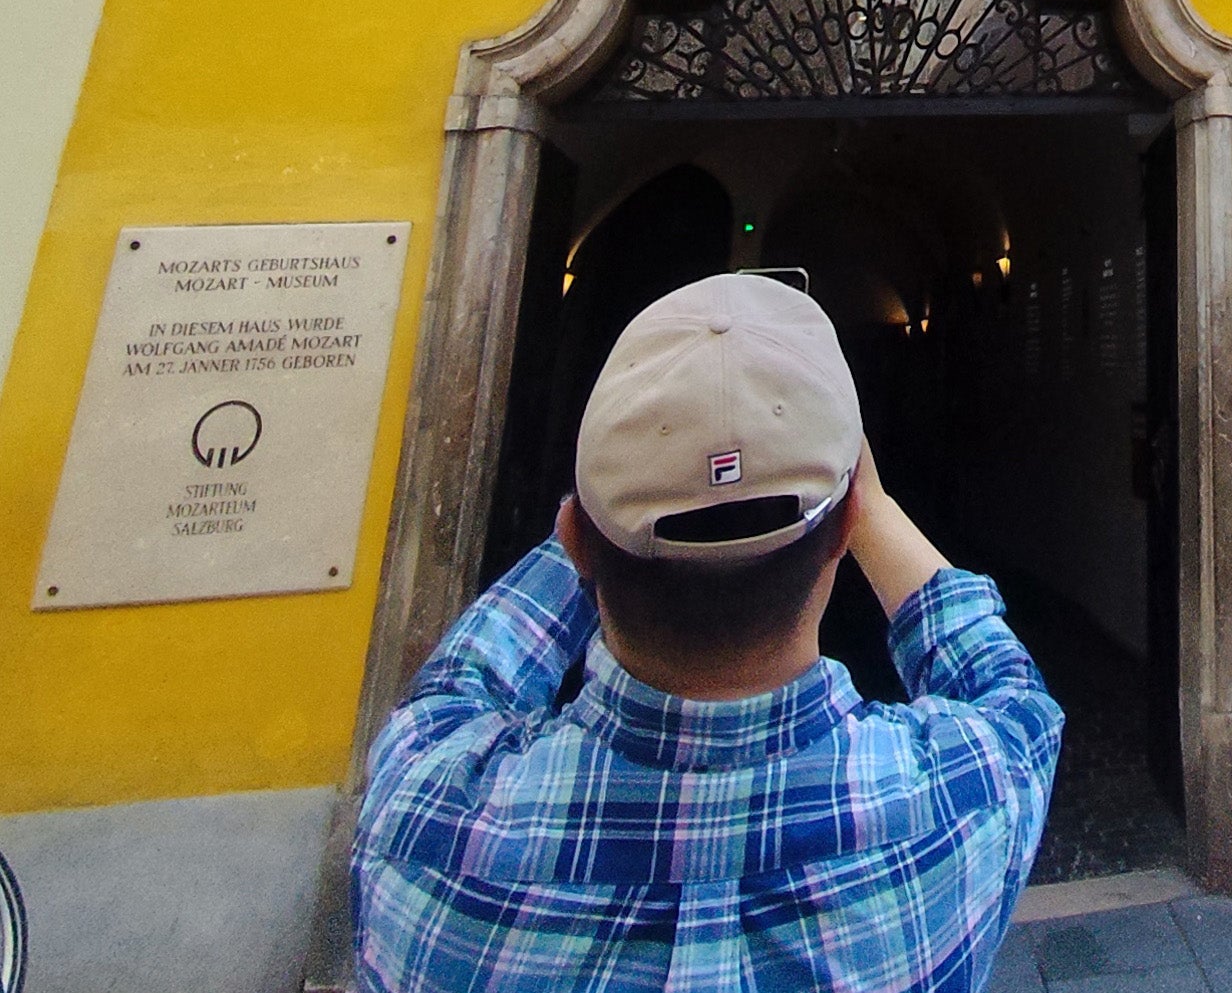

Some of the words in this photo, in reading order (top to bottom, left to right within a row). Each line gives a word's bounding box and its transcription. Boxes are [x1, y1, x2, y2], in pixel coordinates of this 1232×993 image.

[158, 259, 242, 274] MOZARTS
[247, 256, 361, 272] GEBURTSHAUS
[175, 277, 249, 292] MOZART
[265, 274, 339, 289] MUSEUM
[149, 323, 166, 337] IN
[171, 321, 234, 336] DIESEM
[239, 319, 280, 333] HAUS
[288, 317, 345, 331] WURDE
[126, 340, 219, 356] WOLFGANG
[225, 334, 287, 352] AMADÉ
[291, 334, 362, 350] MOZART
[122, 362, 151, 376] AM
[245, 357, 276, 371] 1756
[282, 354, 356, 370] GEBOREN
[183, 482, 248, 499] STIFTUNG
[166, 499, 256, 519] MOZARTEUM
[171, 518, 244, 536] SALZBURG
